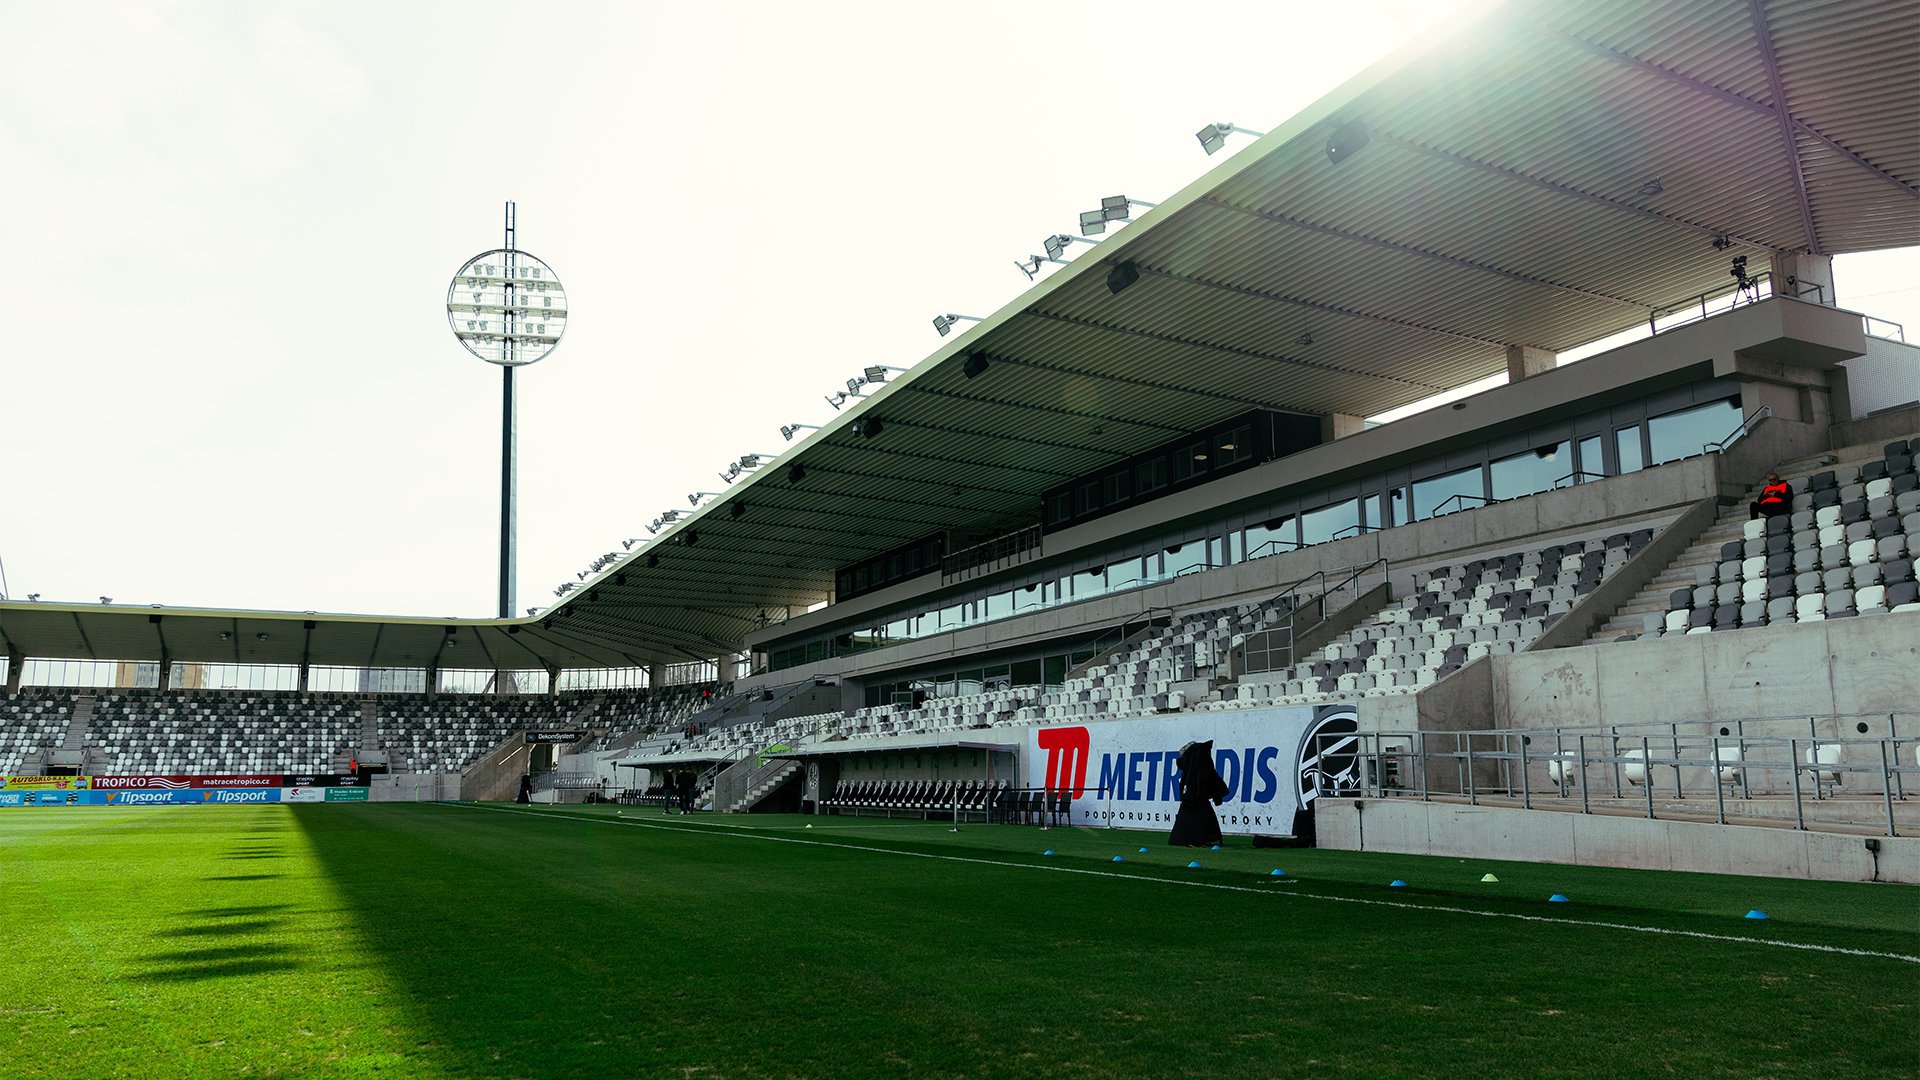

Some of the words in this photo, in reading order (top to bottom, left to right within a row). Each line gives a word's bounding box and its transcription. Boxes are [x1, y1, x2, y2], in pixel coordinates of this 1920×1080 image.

[1097, 746, 1279, 804] METRDIS
[95, 778, 146, 787] TROPICO
[203, 778, 270, 786] matracetropico.cz
[120, 791, 173, 804] Tipsport
[216, 790, 268, 803] Tipsport
[1085, 810, 1178, 822] PODPORUJEM
[1221, 815, 1272, 826] TROKY
